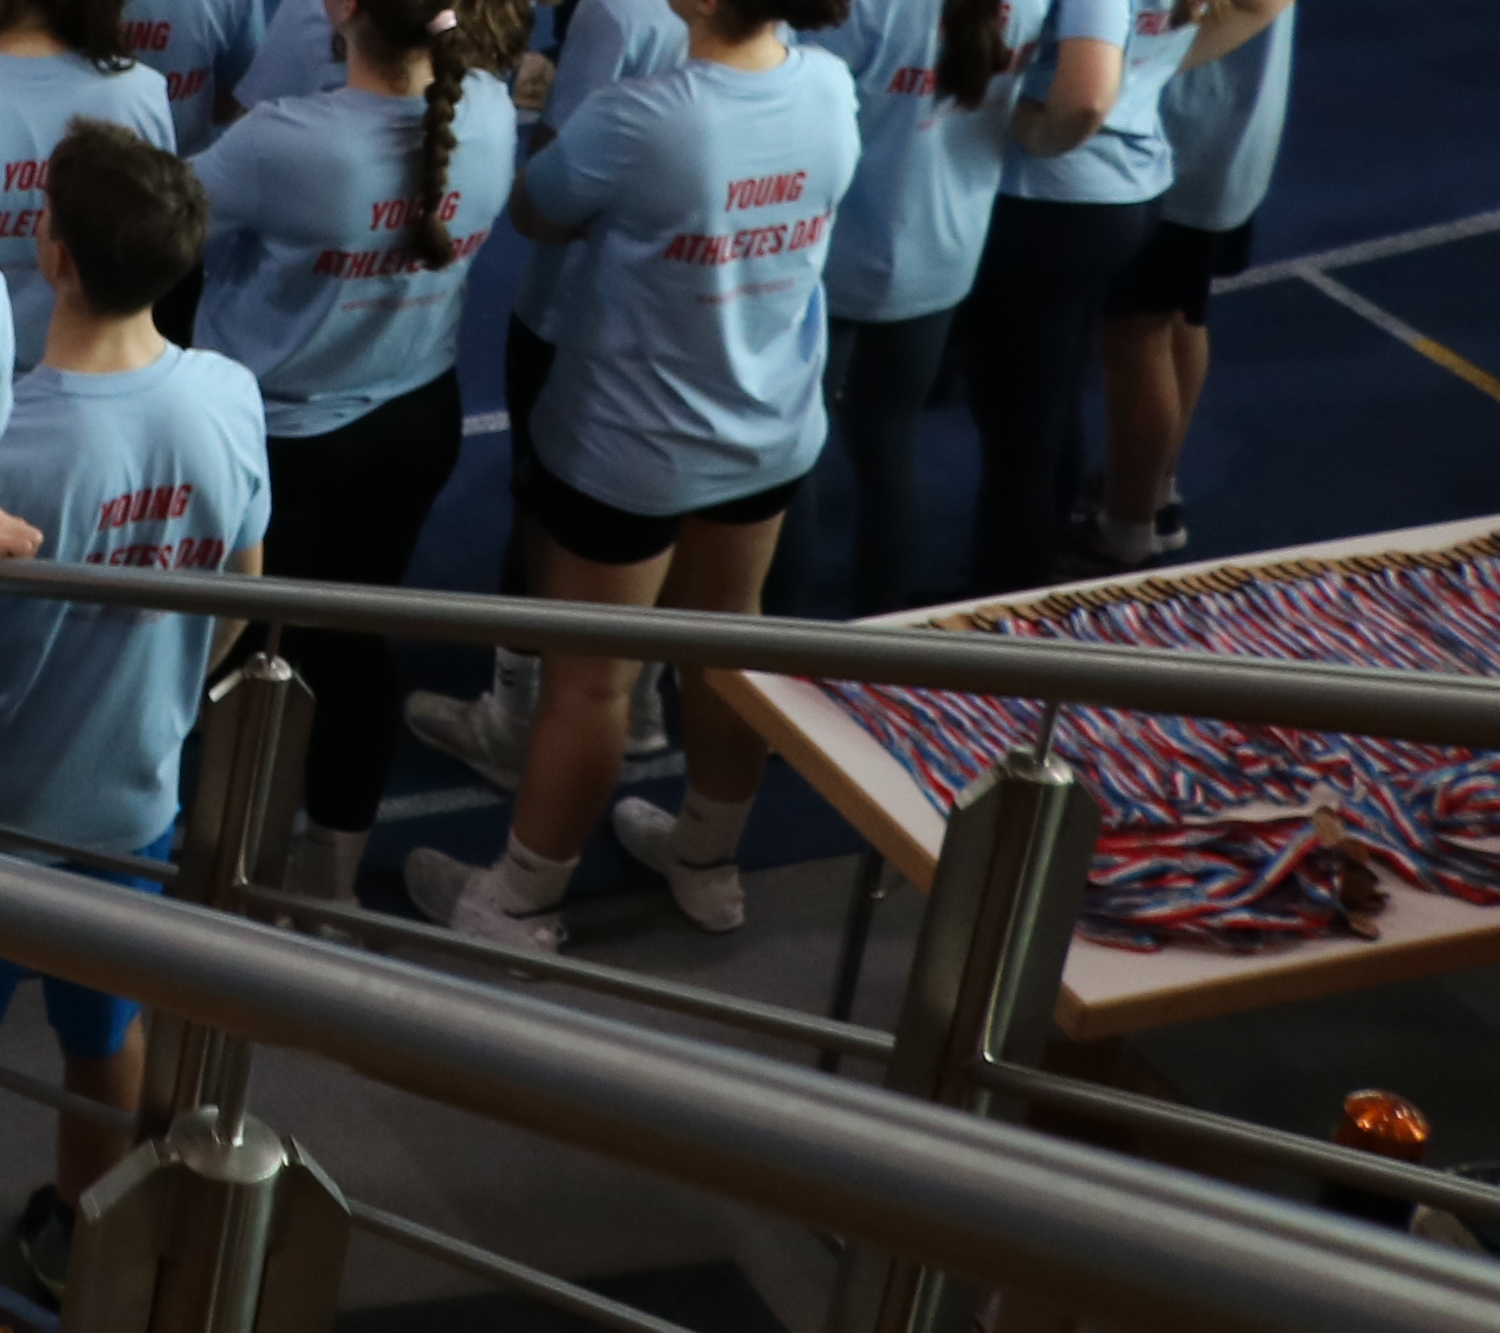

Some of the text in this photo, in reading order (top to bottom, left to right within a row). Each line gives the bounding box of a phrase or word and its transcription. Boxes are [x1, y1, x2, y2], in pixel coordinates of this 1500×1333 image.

[4, 159, 51, 192] YOU
[725, 171, 807, 212] YOUNG
[99, 484, 193, 533] YOUNG
